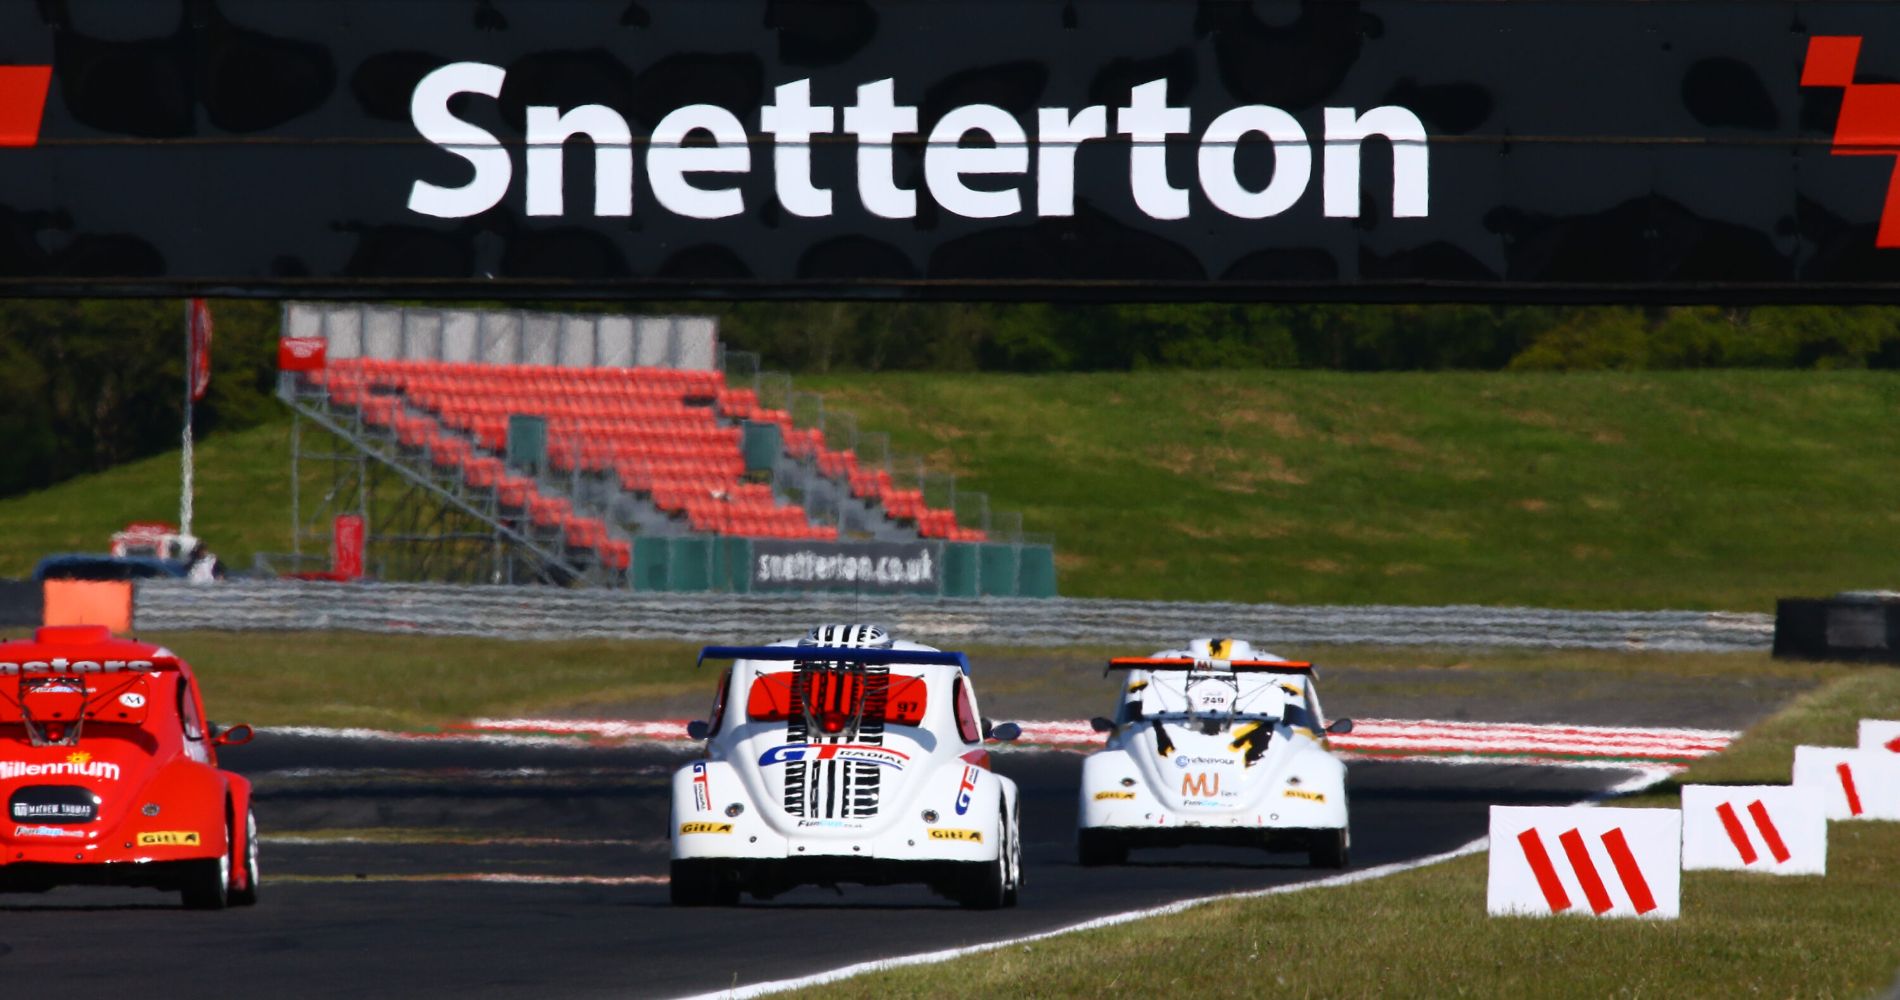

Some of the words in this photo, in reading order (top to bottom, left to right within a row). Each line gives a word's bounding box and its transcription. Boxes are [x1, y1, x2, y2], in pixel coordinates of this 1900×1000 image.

[408, 60, 1430, 221] Snetterton
[1202, 696, 1225, 704] 249
[897, 701, 918, 712] 97
[839, 749, 905, 767] RADIAL
[682, 823, 713, 833] Giti
[932, 830, 963, 839] Giti
